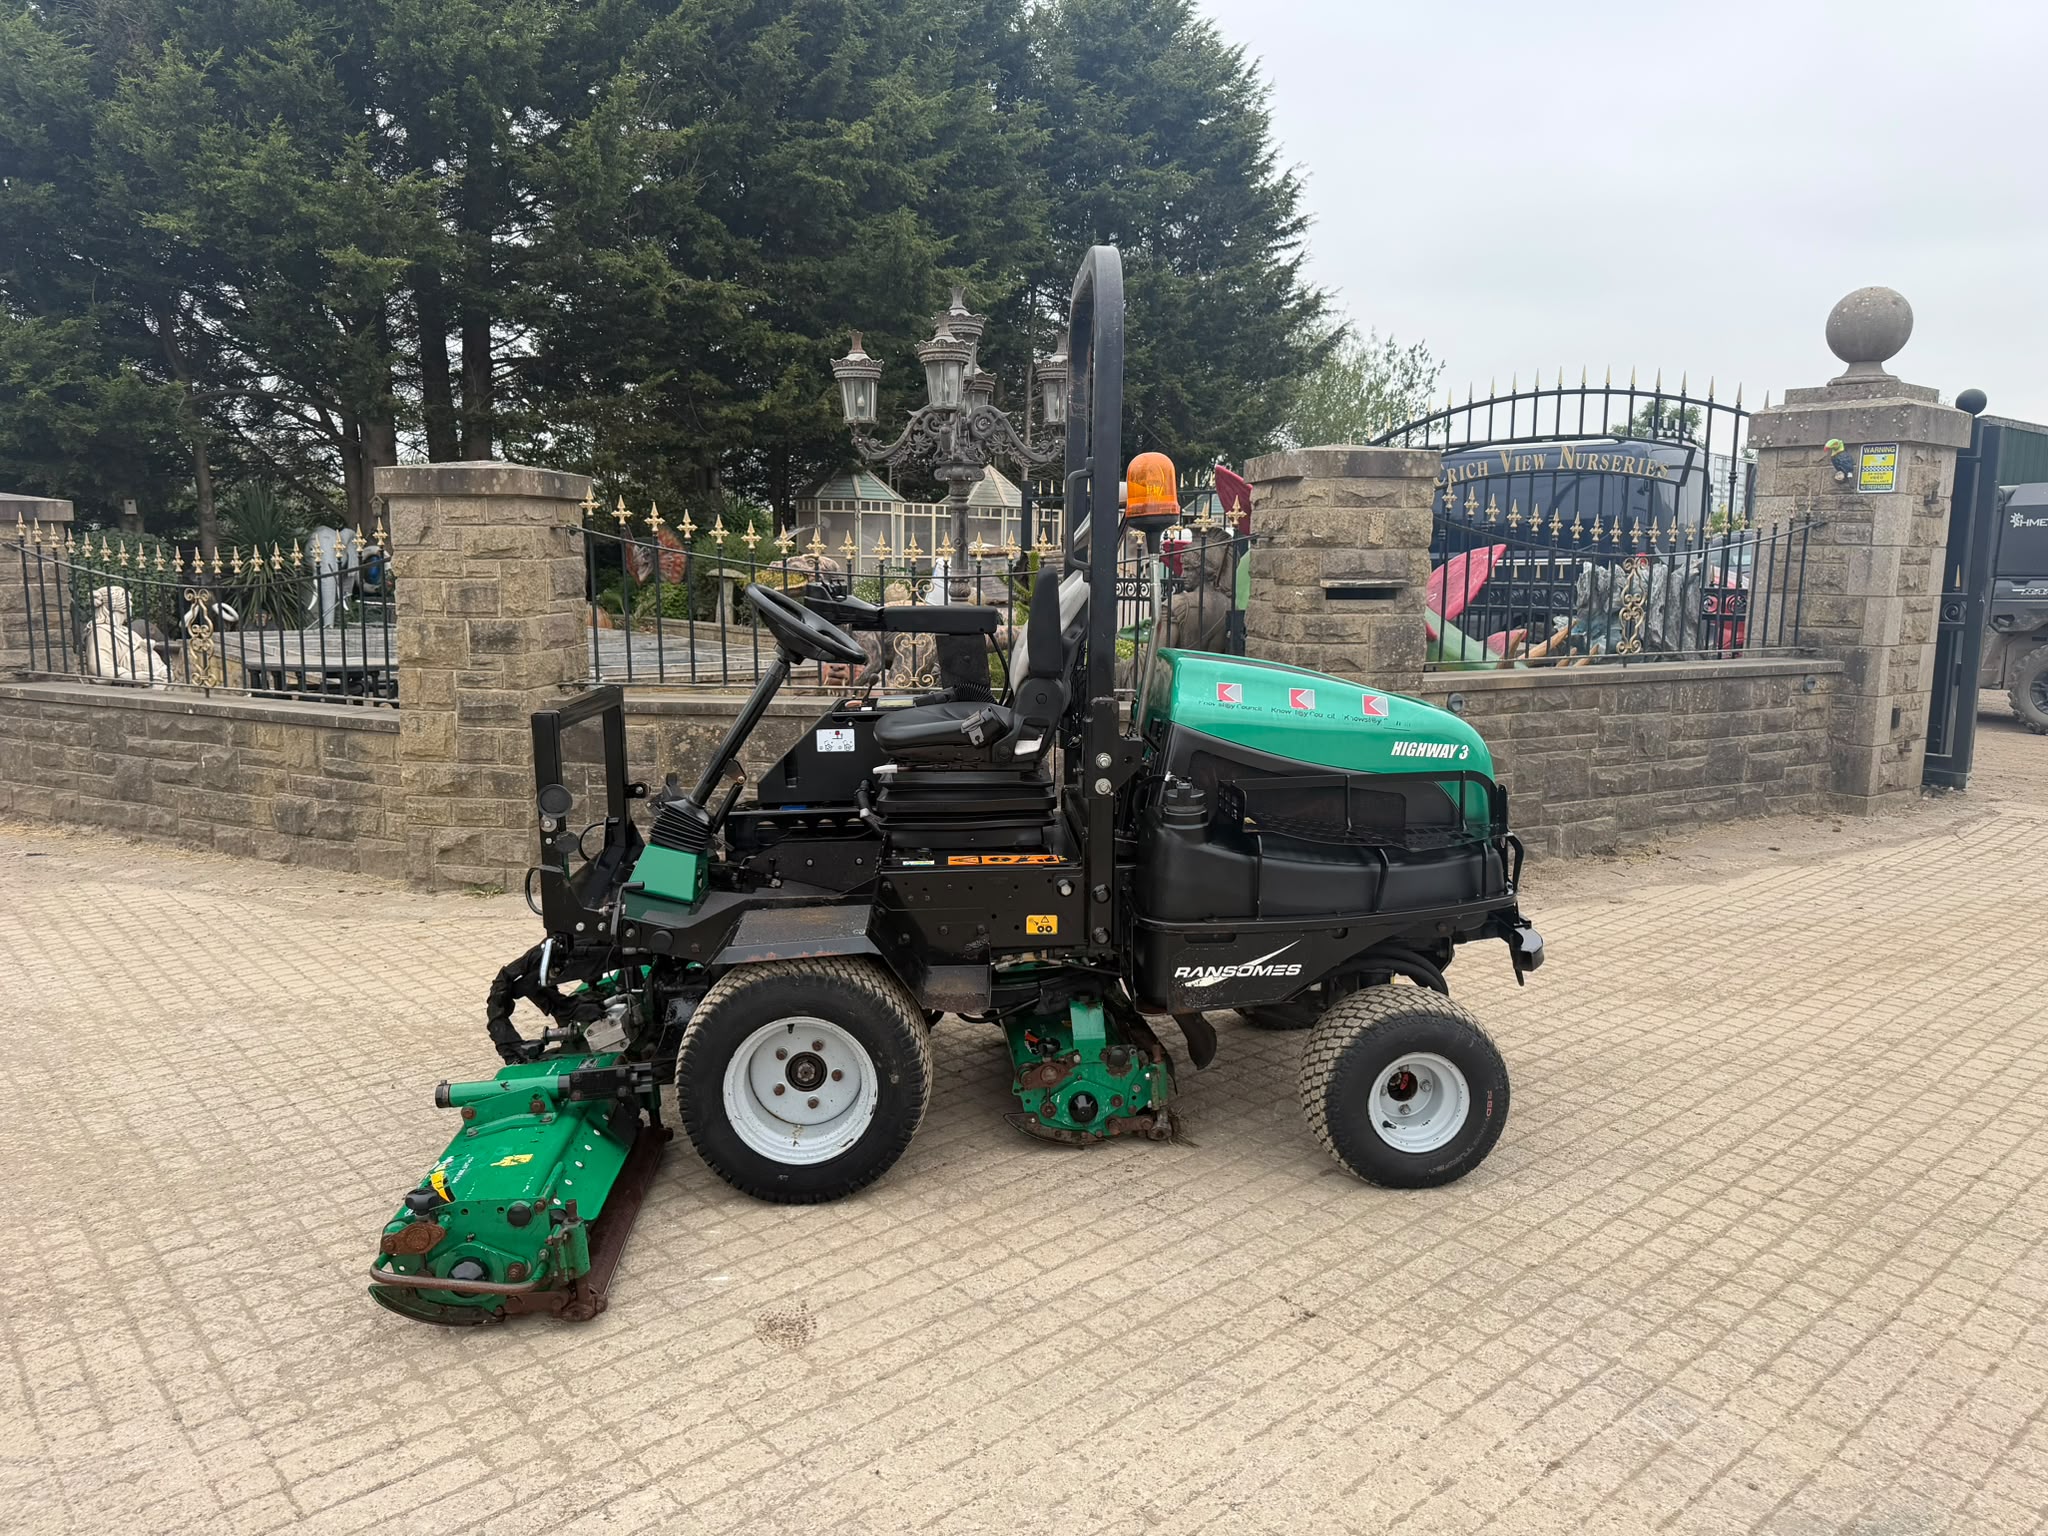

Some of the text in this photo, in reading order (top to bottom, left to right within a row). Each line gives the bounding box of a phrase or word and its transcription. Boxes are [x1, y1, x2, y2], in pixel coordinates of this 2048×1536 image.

[1499, 449, 1547, 473] VIEW
[1557, 445, 1670, 479] NURSERIES
[1391, 741, 1470, 760] HIGHWAY 3
[1174, 964, 1303, 978] RANSOMES
